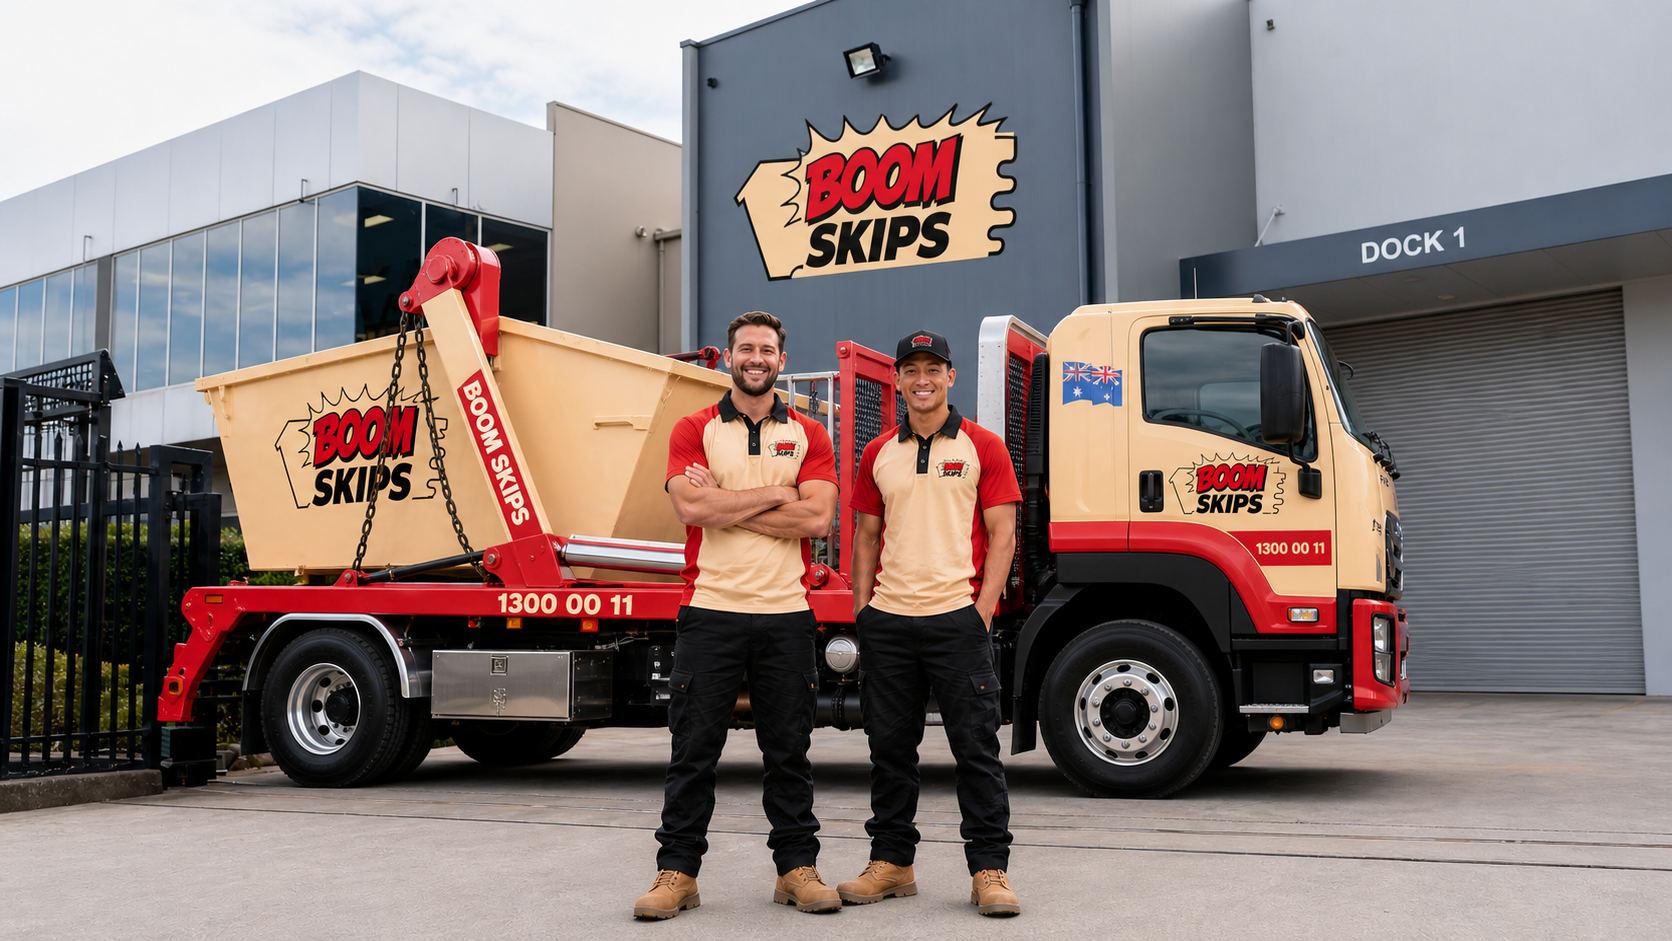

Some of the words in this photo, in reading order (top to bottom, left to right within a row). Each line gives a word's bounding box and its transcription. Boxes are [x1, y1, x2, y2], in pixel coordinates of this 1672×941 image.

[805, 133, 964, 227] BOOM
[805, 211, 952, 268] SKIPS
[1361, 229, 1445, 264] DOCK
[1453, 226, 1465, 248] 1
[313, 405, 420, 469] BOOM
[463, 379, 504, 455] BOOM
[491, 453, 530, 526] SKIPS
[312, 462, 413, 507] SKIPS
[1196, 462, 1268, 495] BOOM
[1196, 494, 1263, 514] SKIPS
[1255, 542, 1288, 555] 1300
[1291, 541, 1310, 555] 00
[1312, 541, 1325, 555] 11
[498, 592, 558, 614] 1300
[565, 593, 602, 616] 00
[610, 594, 633, 616] 11
